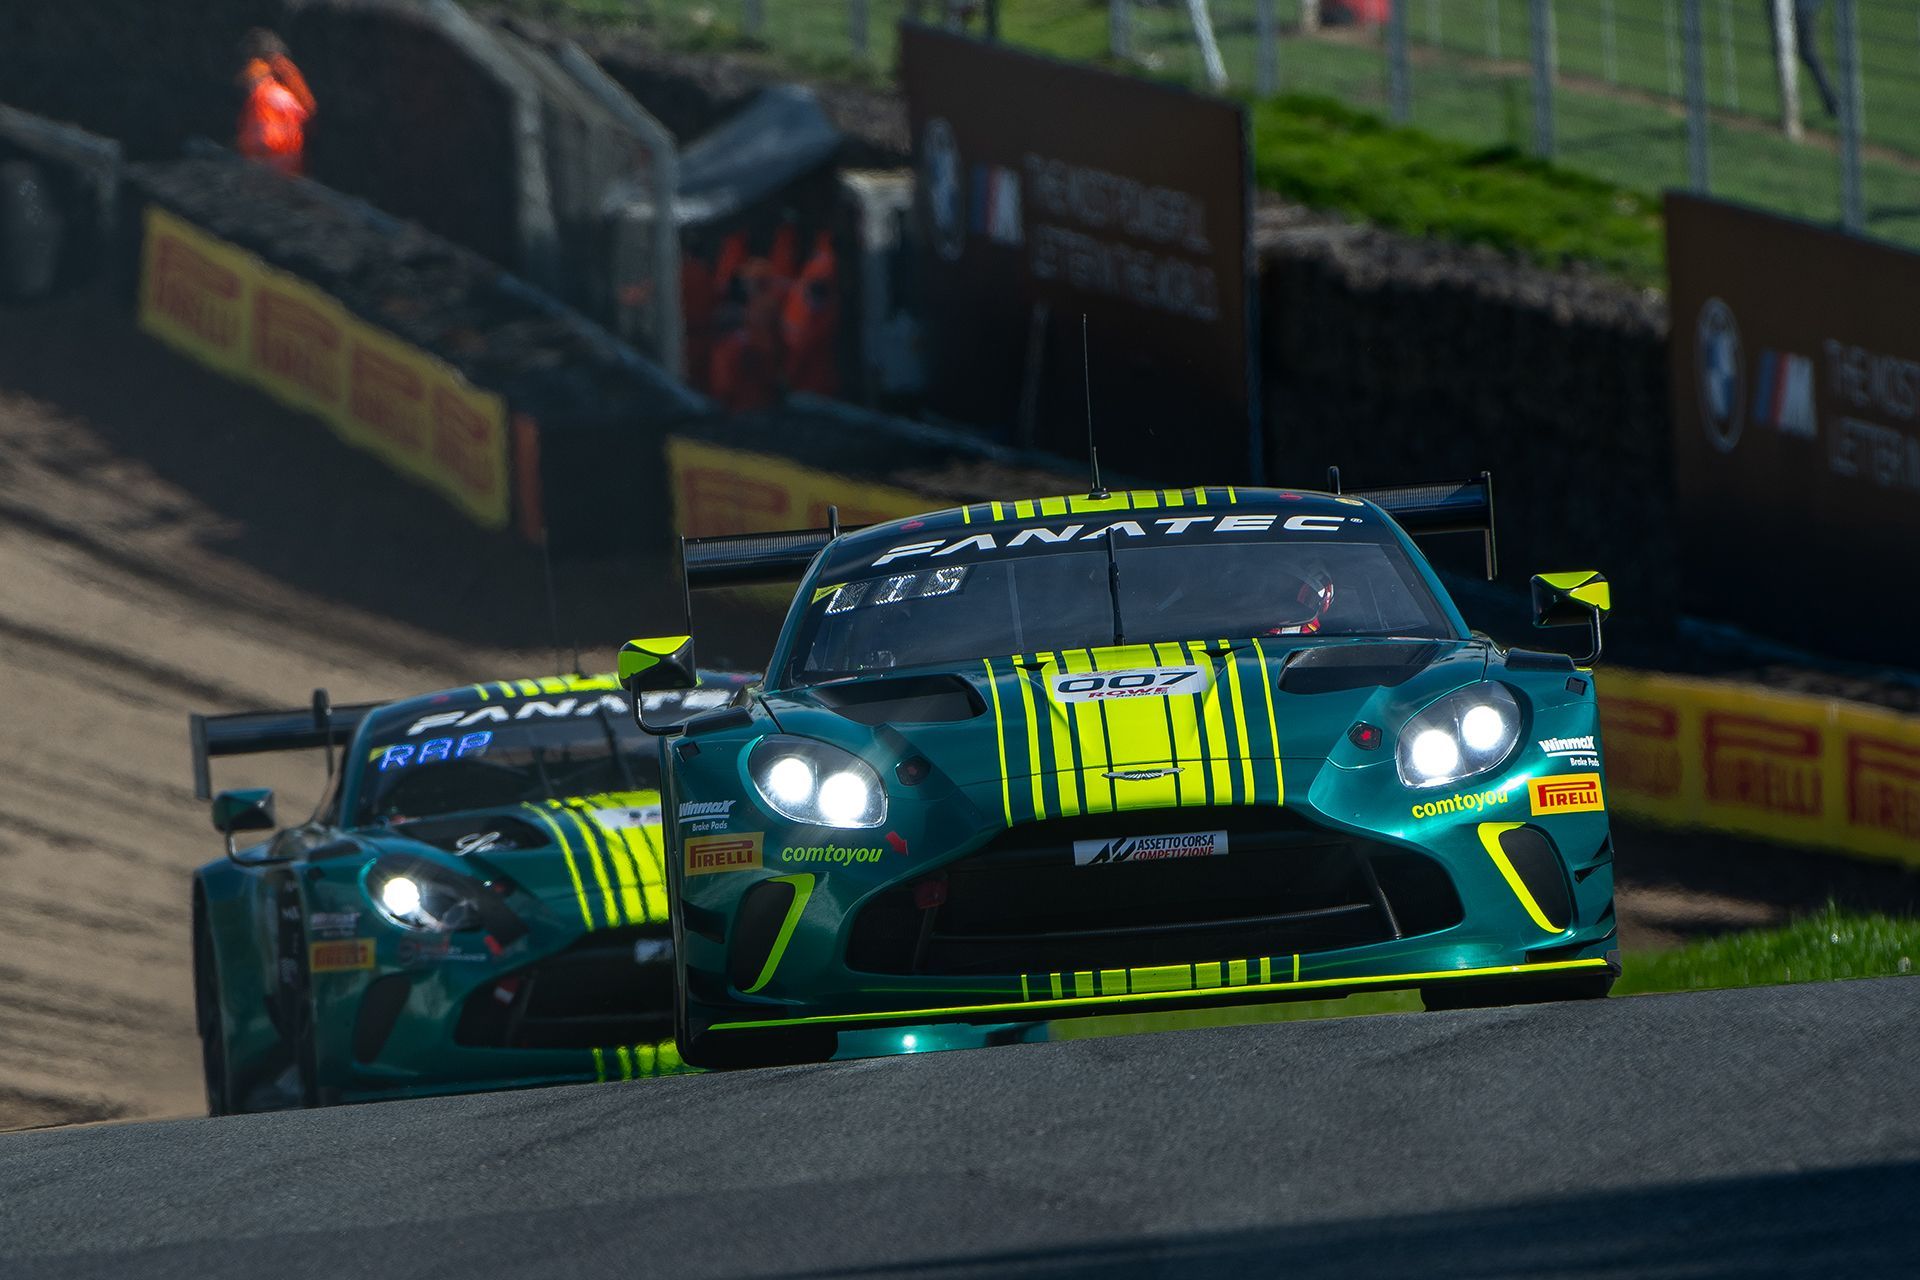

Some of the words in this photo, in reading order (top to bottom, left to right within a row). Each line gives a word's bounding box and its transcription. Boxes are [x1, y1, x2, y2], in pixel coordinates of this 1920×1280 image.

[870, 515, 1346, 567] FANATEC
[1057, 670, 1198, 693] 007
[1088, 687, 1169, 698] ROWE
[1411, 788, 1508, 819] comtoyou
[1538, 781, 1597, 808] PIRELLI
[692, 822, 709, 831] Brake
[711, 820, 728, 830] Pads
[1137, 837, 1181, 850] ASSETTO
[1181, 834, 1215, 848] CORSA
[689, 840, 753, 868] PIRELLI
[781, 844, 883, 866] comtoyou
[1133, 847, 1214, 861] COMPETIZIONE
